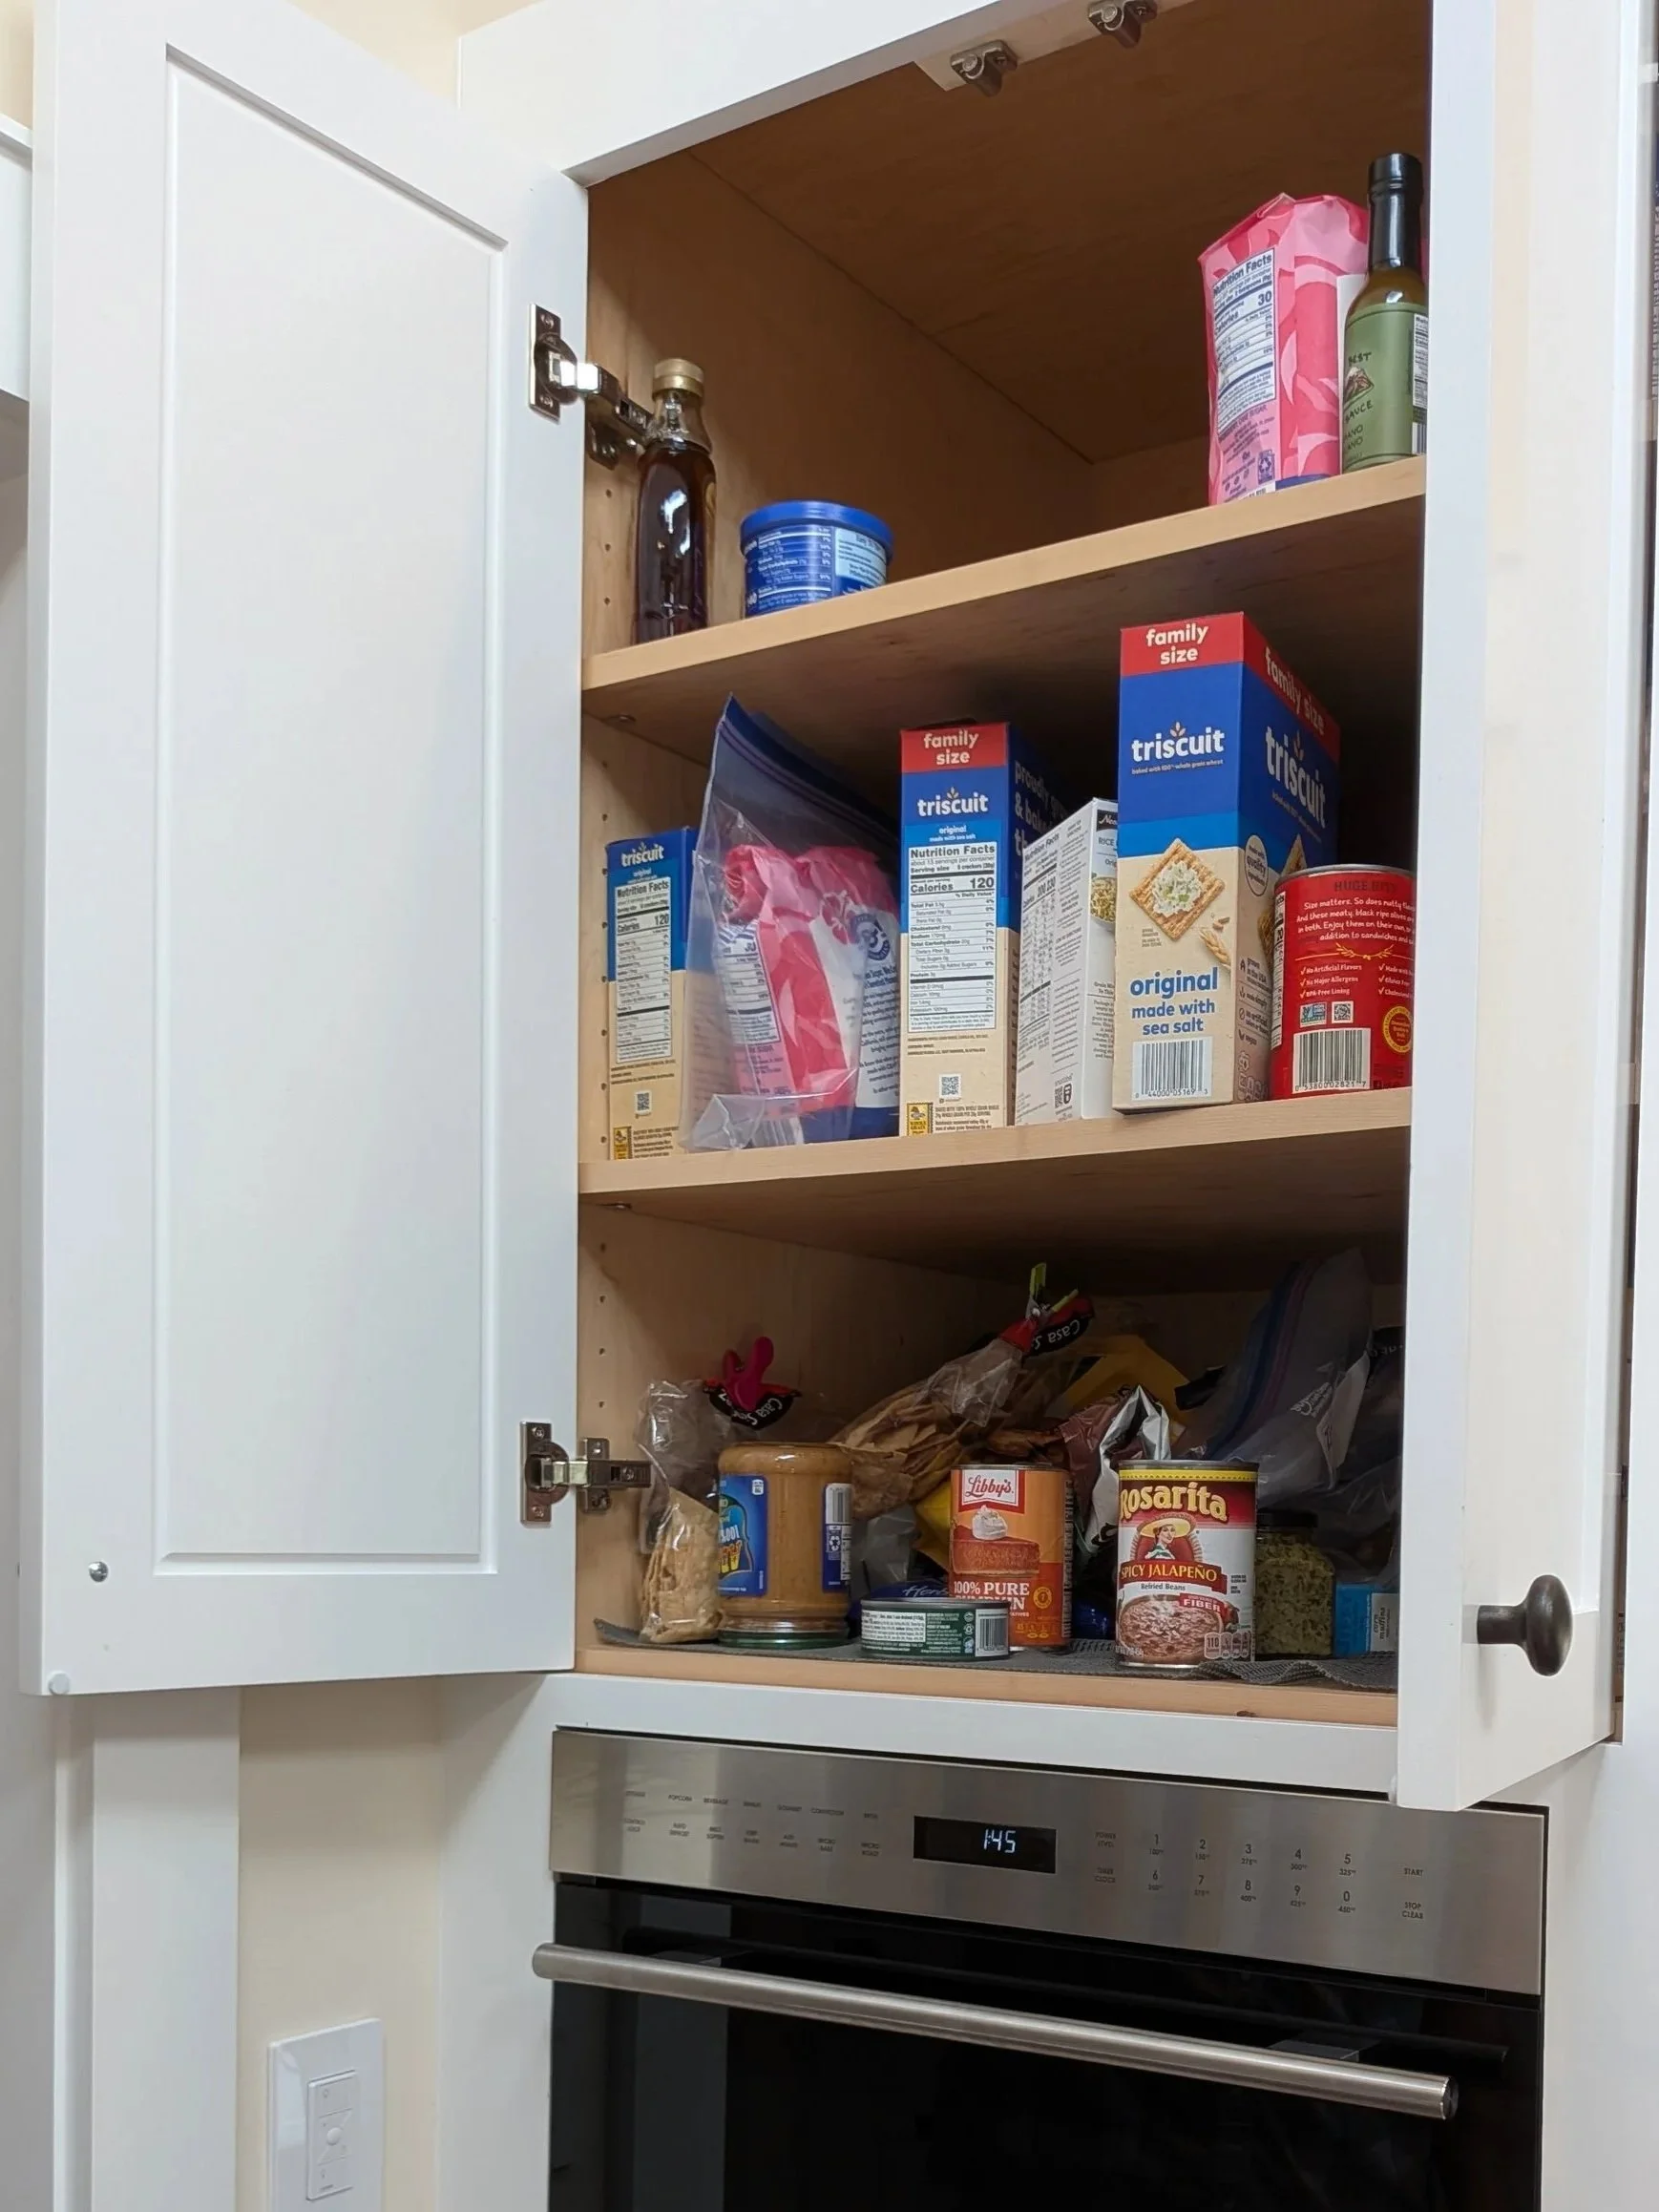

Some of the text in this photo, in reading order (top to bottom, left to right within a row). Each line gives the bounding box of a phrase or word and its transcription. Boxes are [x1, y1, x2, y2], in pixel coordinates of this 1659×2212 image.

[1245, 254, 1272, 273] Facts
[1257, 290, 1272, 306] 30
[1145, 622, 1209, 647] family
[1160, 646, 1199, 665] size
[1264, 646, 1325, 736] family size
[923, 729, 979, 748] family
[1131, 727, 1226, 762] triscuit
[936, 749, 970, 766] size
[1265, 726, 1327, 829] triscuit
[917, 791, 989, 817] triscuit
[1015, 791, 1024, 820] &
[938, 825, 967, 835] original
[1099, 836, 1115, 846] RICE
[621, 844, 665, 868] triscuit
[911, 844, 996, 858] Nutrition Facts
[618, 880, 669, 897] Nutrition Facts
[911, 876, 995, 894] Calories 120
[1304, 901, 1318, 910] Size
[1365, 897, 1382, 906] does
[1383, 900, 1402, 911] nutty
[654, 914, 669, 925] 120
[1376, 910, 1390, 918] ripe
[1323, 920, 1345, 931] Enjoy
[1319, 932, 1351, 941] addition
[1360, 932, 1397, 941] sandwiches
[1313, 963, 1340, 973] Artificial
[1340, 962, 1362, 971] Flavors
[1129, 966, 1220, 1000] original
[1313, 977, 1331, 986] Major
[1331, 975, 1359, 984] Allergens
[1331, 987, 1351, 996] Lining
[1131, 999, 1216, 1020] made with
[1142, 1017, 1205, 1037] sea salt
[1047, 1319, 1081, 1344] Casa
[755, 1398, 783, 1418] Casa
[1120, 1481, 1228, 1523] Rosarita
[1121, 1563, 1218, 1582] SPICY JALAPEÑO
[954, 1581, 1031, 1596] 100% PURE
[1164, 1583, 1186, 1591] Beans
[1183, 1598, 1222, 1613] FIBER
[1207, 1636, 1220, 1649] 110
[1154, 1833, 1159, 1845] 1
[1199, 1838, 1207, 1850] 2
[1245, 1843, 1252, 1854] 3
[1294, 1848, 1302, 1860] 4
[1343, 1853, 1352, 1864] 5
[1152, 1869, 1158, 1881] 6
[1403, 1867, 1424, 1876] START
[1198, 1874, 1205, 1885] 7
[1245, 1879, 1252, 1891] 8
[1293, 1885, 1301, 1896] 9
[1342, 1890, 1351, 1902] 0
[1403, 1901, 1422, 1909] STOP
[1401, 1909, 1424, 1919] CLEAR
